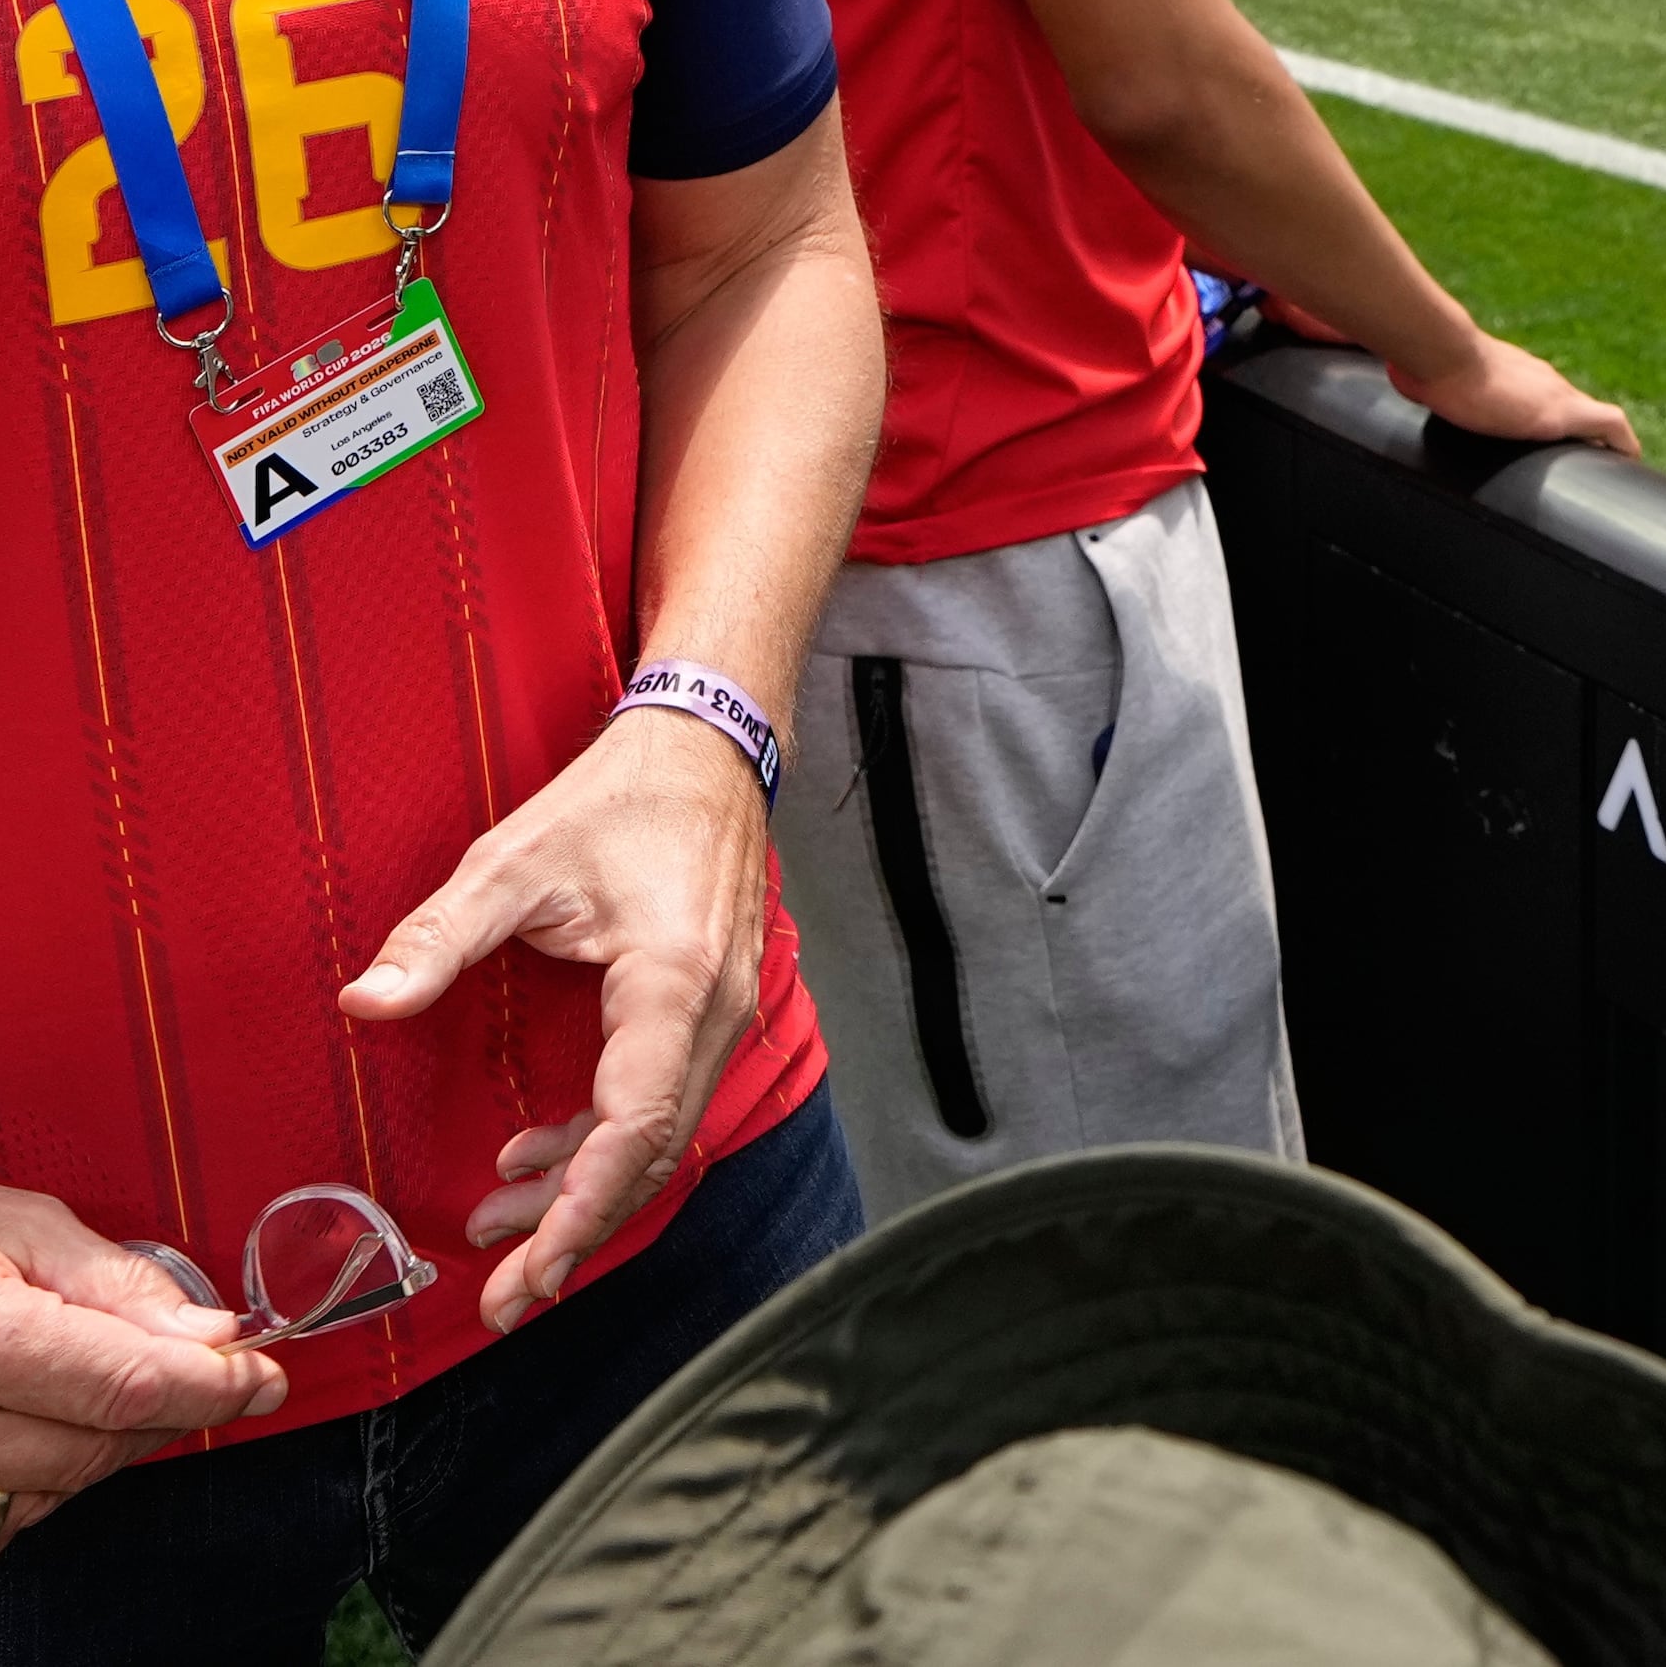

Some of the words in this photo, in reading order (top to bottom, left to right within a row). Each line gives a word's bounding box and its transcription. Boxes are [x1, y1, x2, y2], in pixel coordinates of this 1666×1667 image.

[227, 441, 254, 464] NOT
[257, 417, 297, 445] VALID
[300, 383, 357, 423] WITHOUT
[359, 335, 437, 385] CHAPERONE
[251, 397, 281, 419] FIFA
[279, 372, 324, 404] WORLD
[324, 356, 350, 378] CUP
[350, 332, 392, 362] 2026
[302, 401, 358, 439] Strategy
[360, 392, 371, 404] &
[370, 350, 444, 398] Governance
[331, 437, 351, 451] Los
[352, 410, 393, 439] Angeles
[331, 422, 409, 477] 003383
[255, 452, 319, 528] A
[710, 688, 762, 746] W93
